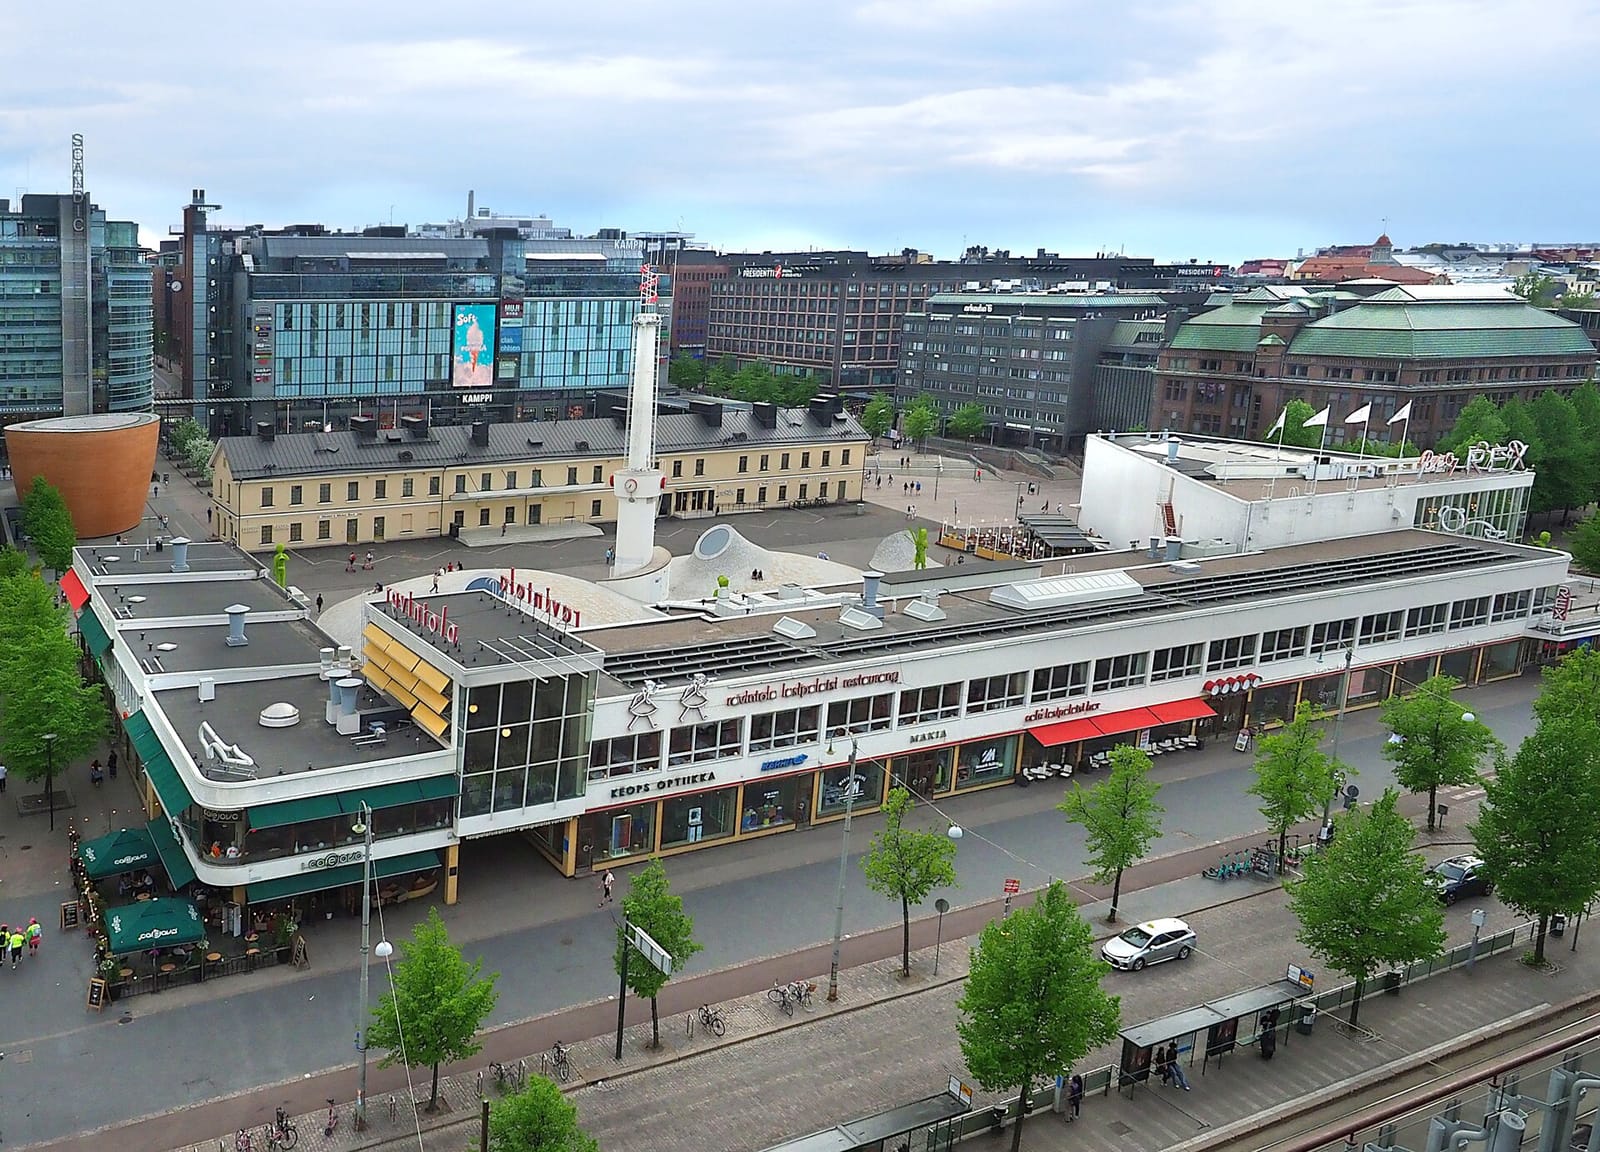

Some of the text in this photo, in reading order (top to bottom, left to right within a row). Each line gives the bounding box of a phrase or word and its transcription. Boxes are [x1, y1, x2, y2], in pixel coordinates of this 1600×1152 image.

[72, 133, 84, 232] SCANDIC
[462, 393, 493, 403] KAMPPI
[1552, 585, 1570, 621] REX
[909, 729, 947, 744] MAKIA
[610, 771, 716, 799] KEOPS OPTIIKKA
